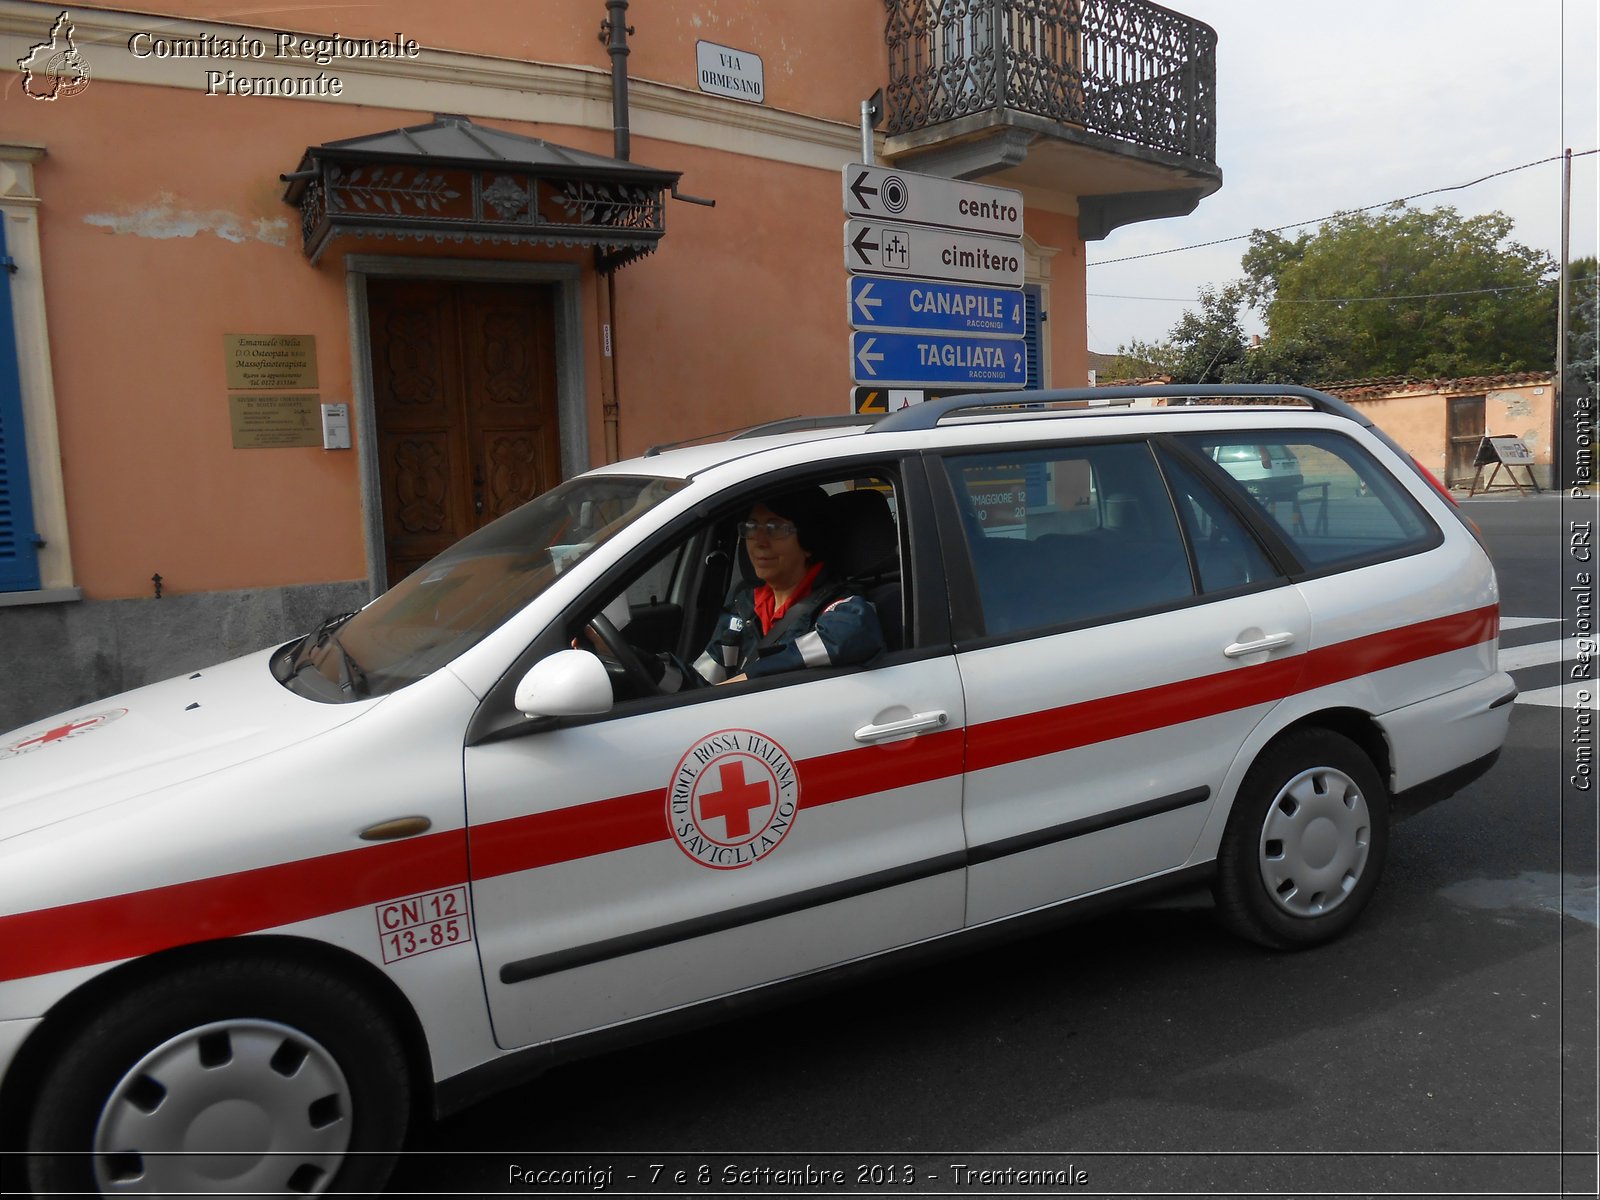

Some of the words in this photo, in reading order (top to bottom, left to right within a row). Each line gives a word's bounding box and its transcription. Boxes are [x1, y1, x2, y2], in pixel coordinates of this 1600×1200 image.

[720, 53, 741, 71] VIA
[702, 69, 760, 95] ORMESANO
[958, 198, 1018, 222] centro
[941, 245, 1019, 273] cimitero
[909, 288, 1003, 319] CANAPILE
[1012, 303, 1021, 324] 4
[966, 319, 1003, 329] RACCONIGI
[917, 343, 1006, 368] TAGLIATA
[1014, 352, 1022, 373] 2
[968, 369, 1006, 380] RACCONIGI
[1017, 491, 1026, 502] 12
[1015, 506, 1026, 518] 20
[672, 763, 699, 815] CROCE
[693, 734, 740, 765] ROSSA
[747, 735, 795, 790] ITALIANA
[677, 802, 795, 865] SAVIGLIANO
[382, 900, 419, 930] CN
[430, 893, 457, 918] 12
[390, 919, 460, 957] 13-85
